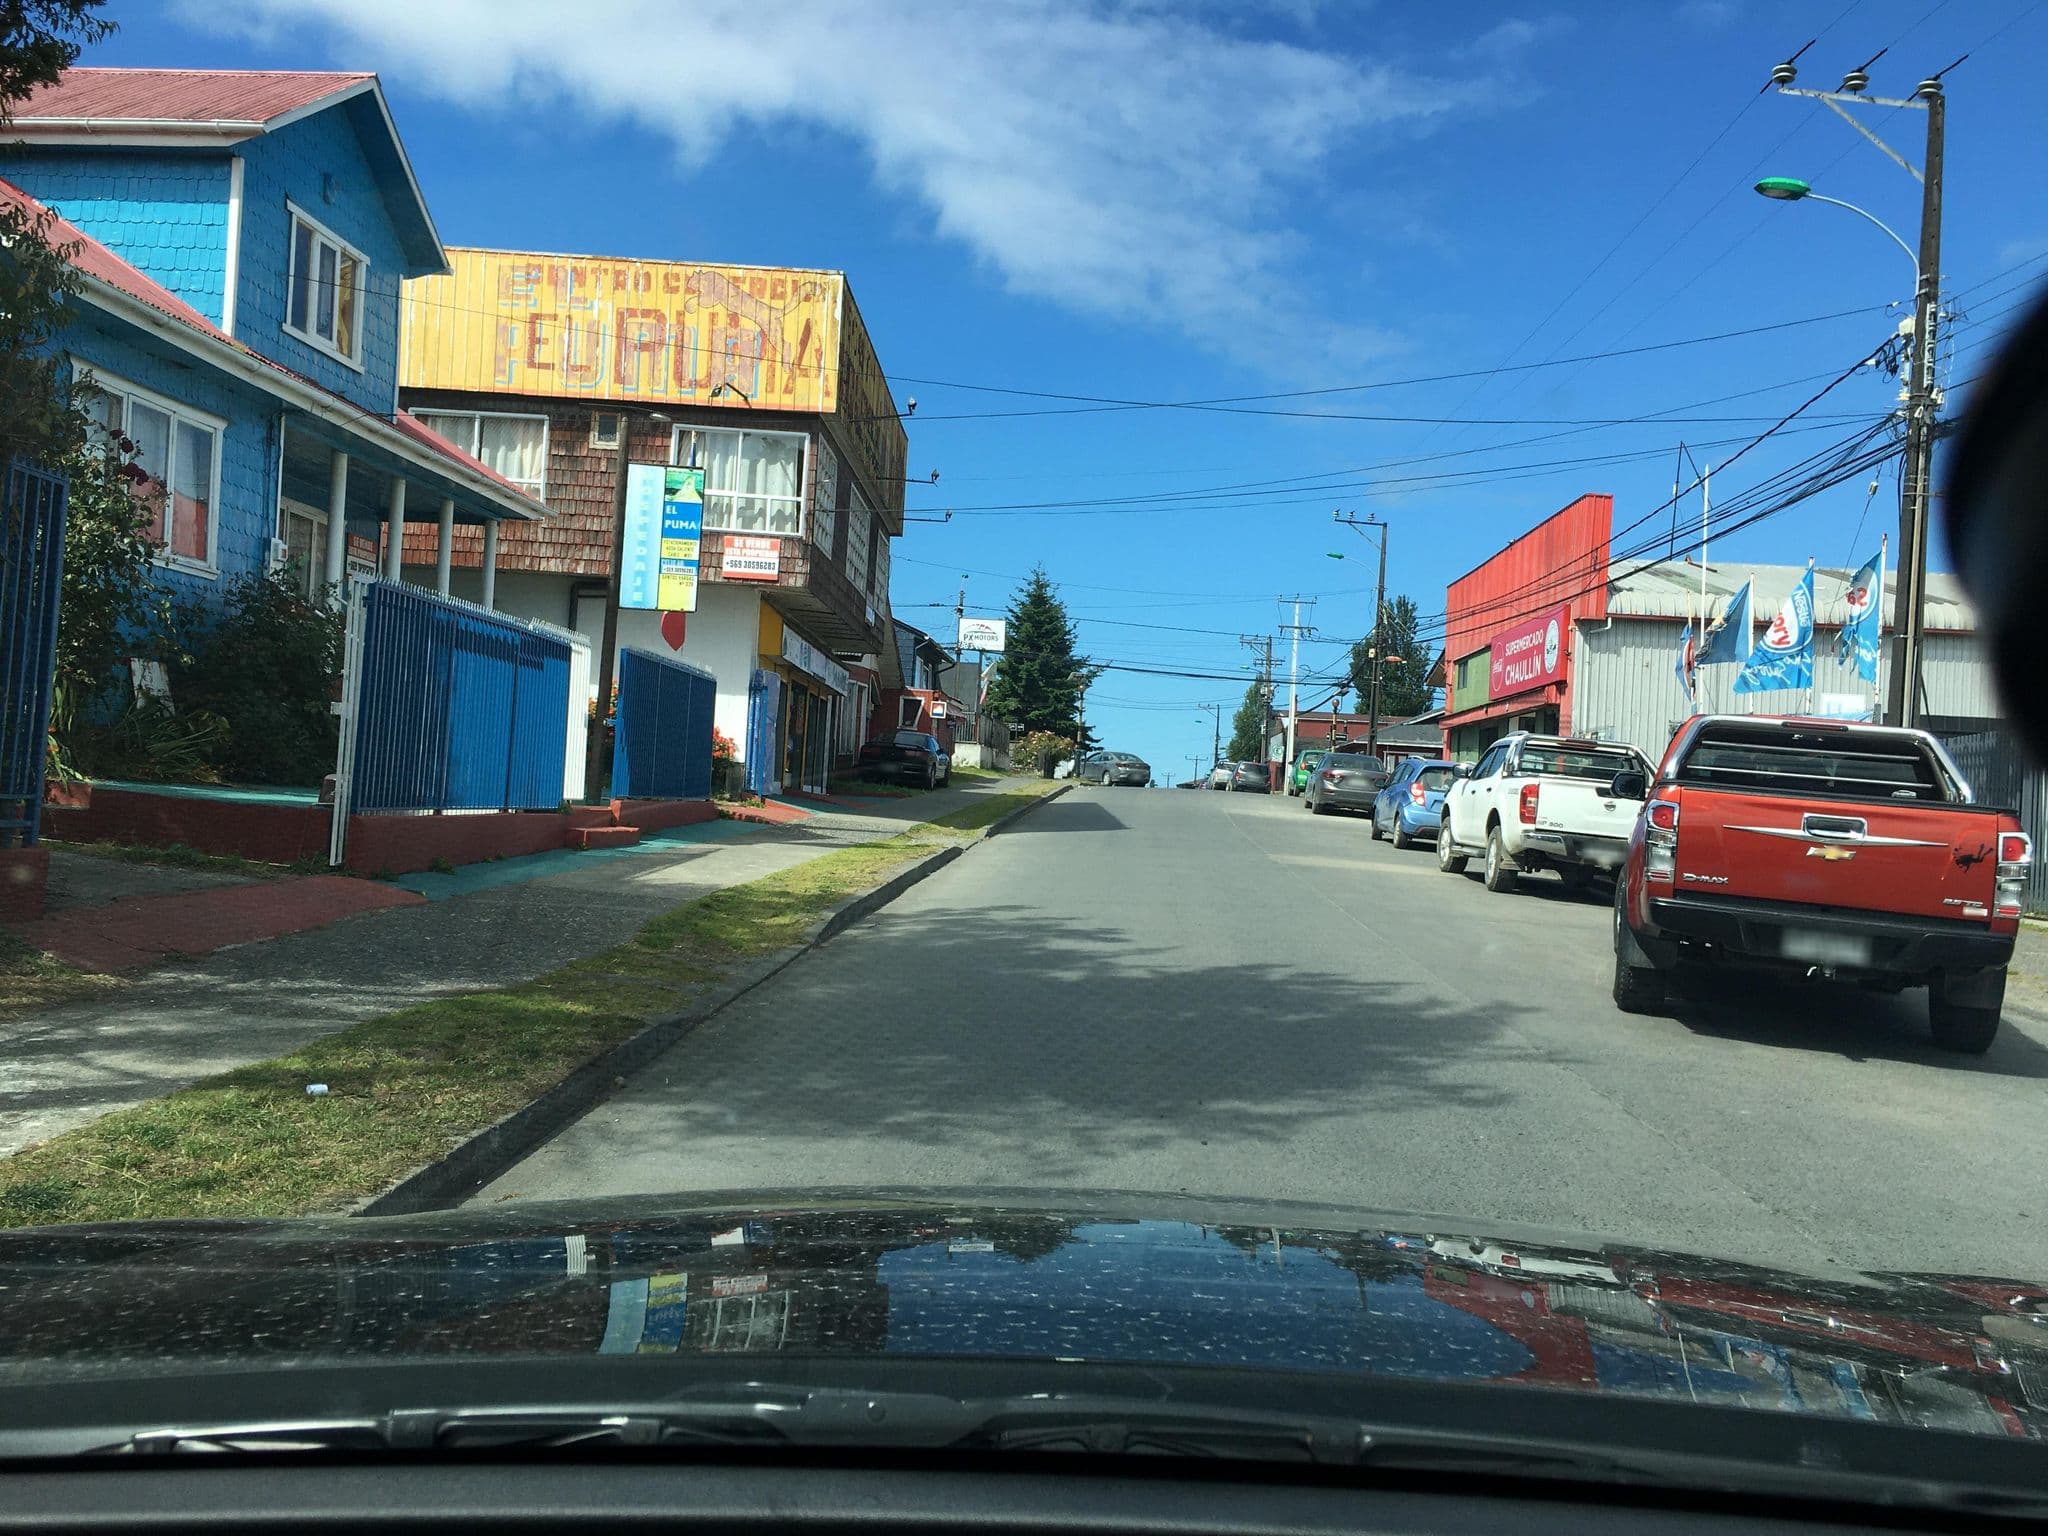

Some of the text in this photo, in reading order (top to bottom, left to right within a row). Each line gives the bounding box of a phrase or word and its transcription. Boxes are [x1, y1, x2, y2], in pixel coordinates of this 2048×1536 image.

[666, 505, 678, 515] EL
[664, 519, 697, 530] PUMA
[726, 559, 776, 570] +569 30596283
[974, 634, 999, 642] MOTORS
[1505, 629, 1544, 656] SUPERMERCADO
[1504, 650, 1542, 686] CHAULLÍN
[1682, 872, 1729, 885] D-MAX
